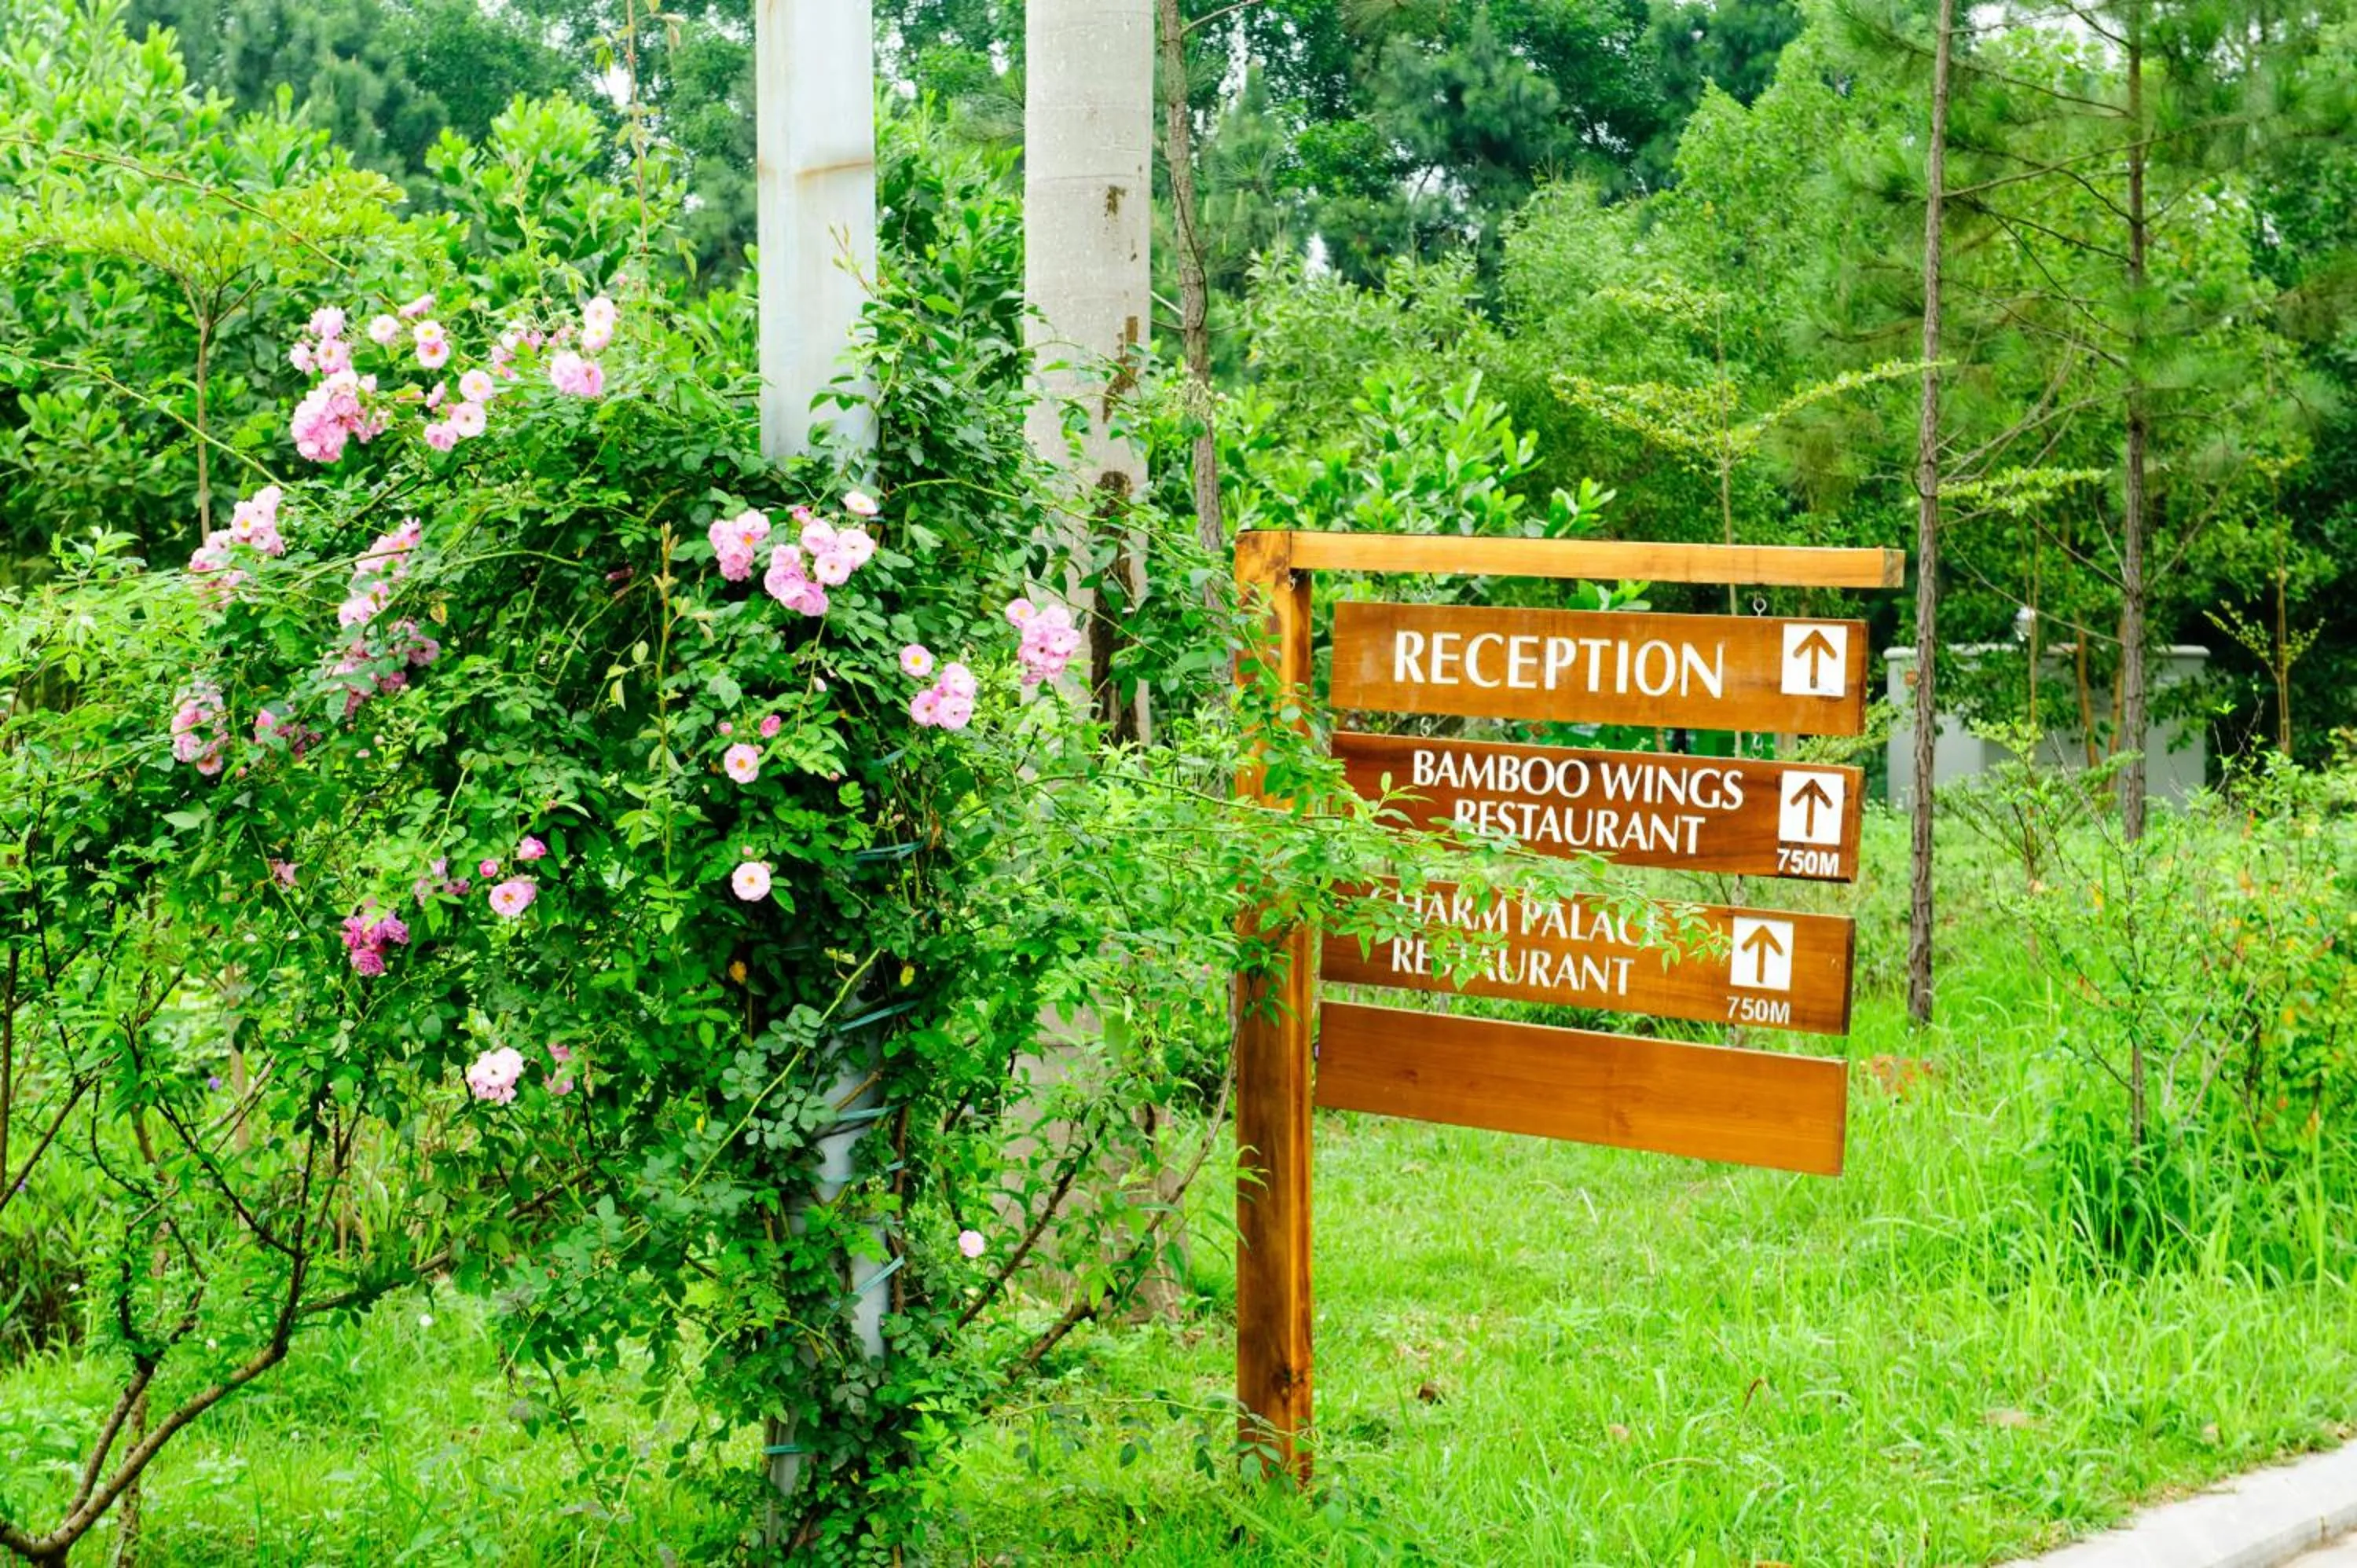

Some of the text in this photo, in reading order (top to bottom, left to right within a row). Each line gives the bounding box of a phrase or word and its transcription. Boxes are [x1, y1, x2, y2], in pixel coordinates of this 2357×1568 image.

[1394, 629, 1725, 698] RECEPTION
[1413, 749, 1744, 810] BAMBOO WINGS
[1776, 848, 1840, 877] 750M
[1369, 886, 1508, 934] HARM
[1727, 995, 1791, 1025] 750M
